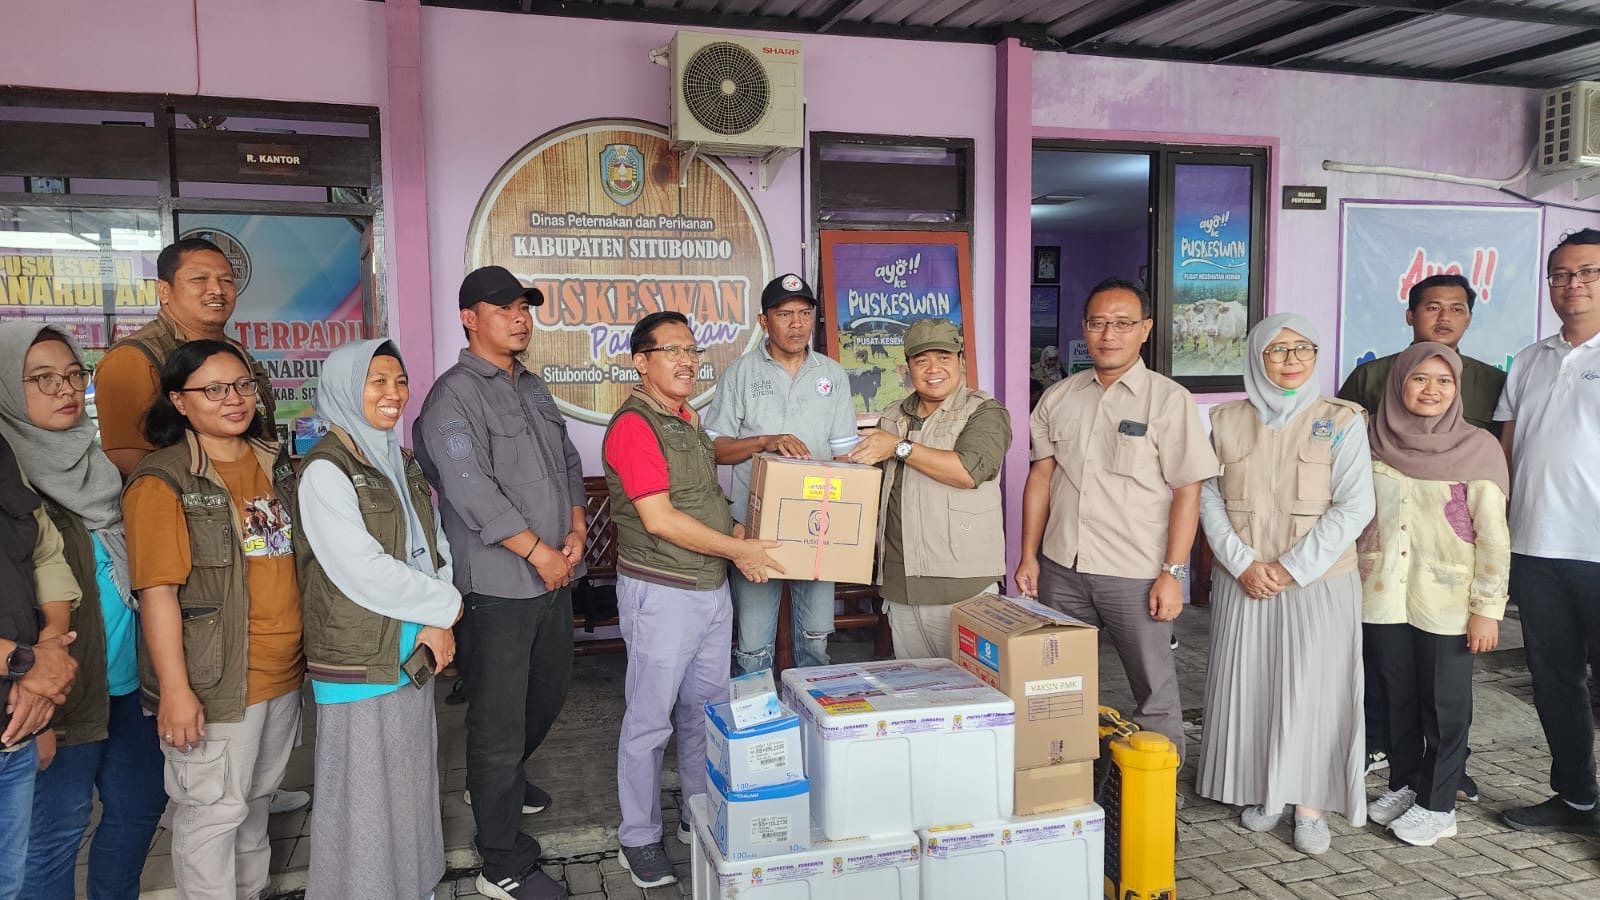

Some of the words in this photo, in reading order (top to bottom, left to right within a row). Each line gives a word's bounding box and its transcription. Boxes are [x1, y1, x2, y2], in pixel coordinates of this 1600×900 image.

[763, 47, 799, 56] SHARP
[246, 154, 257, 163] R.
[259, 155, 301, 165] KANTOR
[532, 213, 564, 227] Dinas
[567, 215, 632, 229] Peternakan
[635, 217, 656, 229] dan
[658, 217, 713, 230] Perikanan
[512, 236, 624, 258] KABUPATEN
[629, 239, 733, 259] SITUBONDO
[1181, 236, 1246, 258] PUSKESWAN
[893, 276, 907, 288] ke
[521, 280, 746, 325] USKESWAN
[848, 289, 950, 316] PUSKESWAN
[856, 337, 879, 345] PUSAT
[543, 367, 603, 383] Situbondo
[275, 387, 299, 401] KAB.
[737, 783, 749, 791] 100
[733, 852, 747, 860] 100
